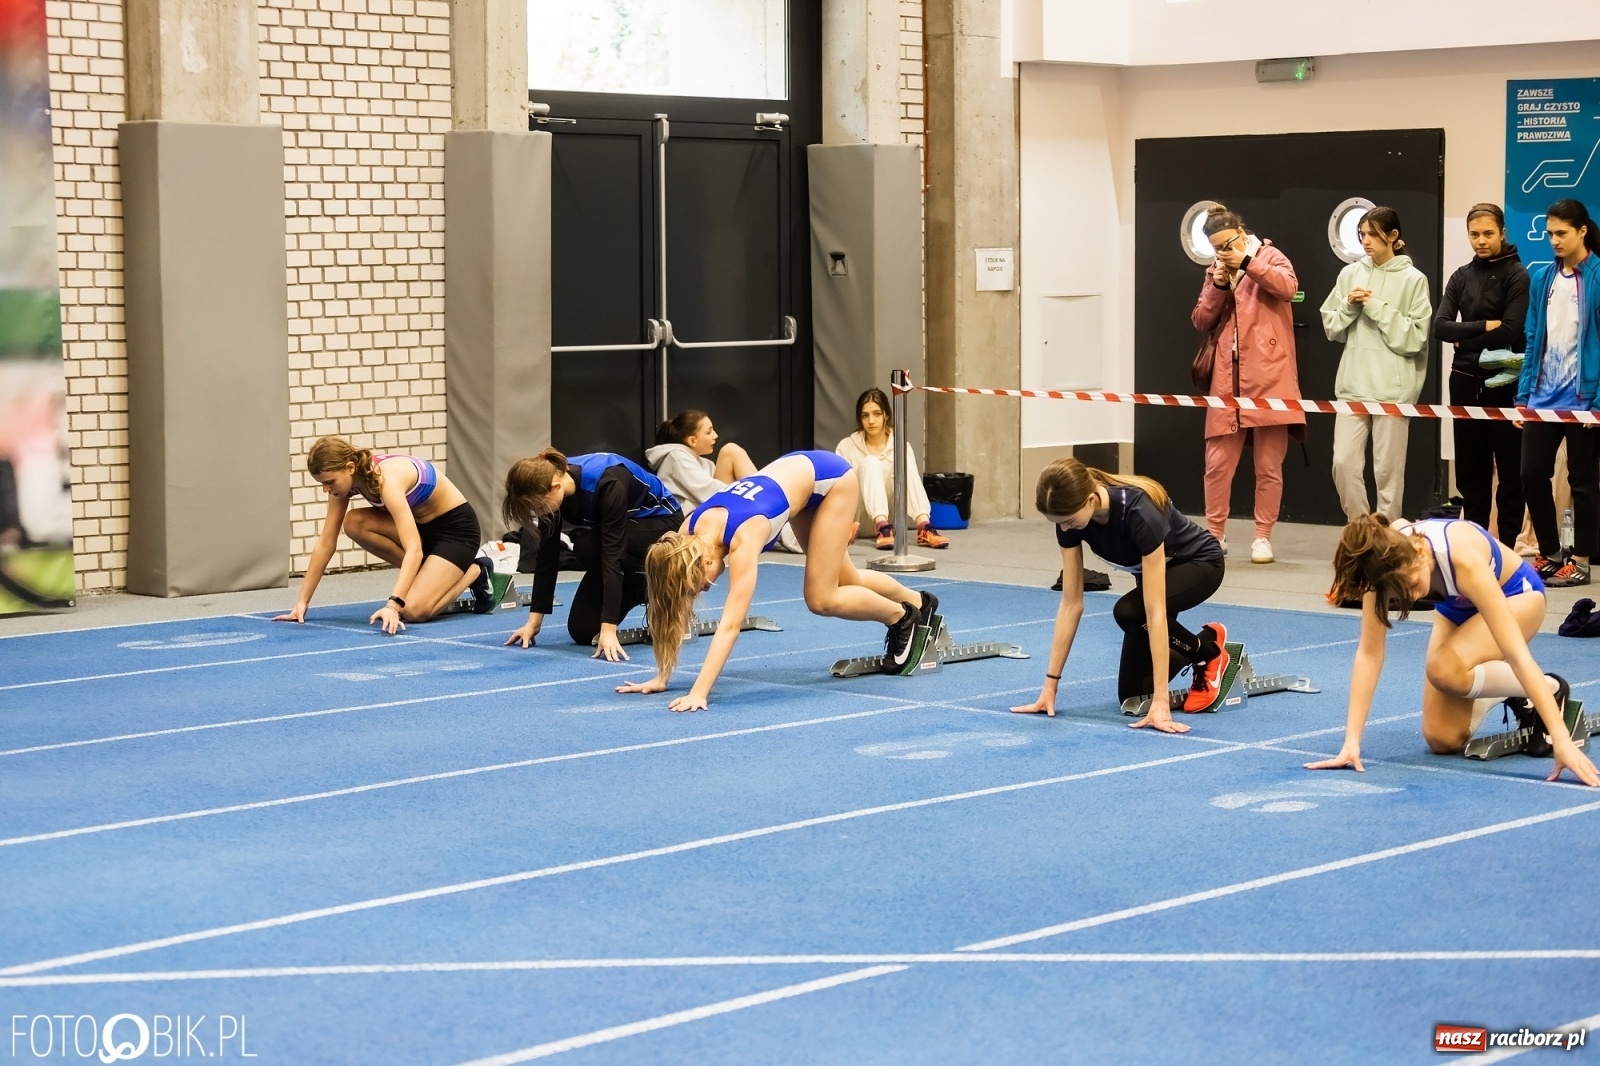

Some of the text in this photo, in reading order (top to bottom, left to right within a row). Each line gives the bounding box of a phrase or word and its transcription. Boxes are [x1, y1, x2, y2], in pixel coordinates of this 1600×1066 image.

[1517, 88, 1554, 97] ZAWSZE
[1517, 102, 1580, 111] GRAJ CZYSTO
[1523, 117, 1567, 125] HISTORIA
[1517, 131, 1571, 140] PRAWDZIWA
